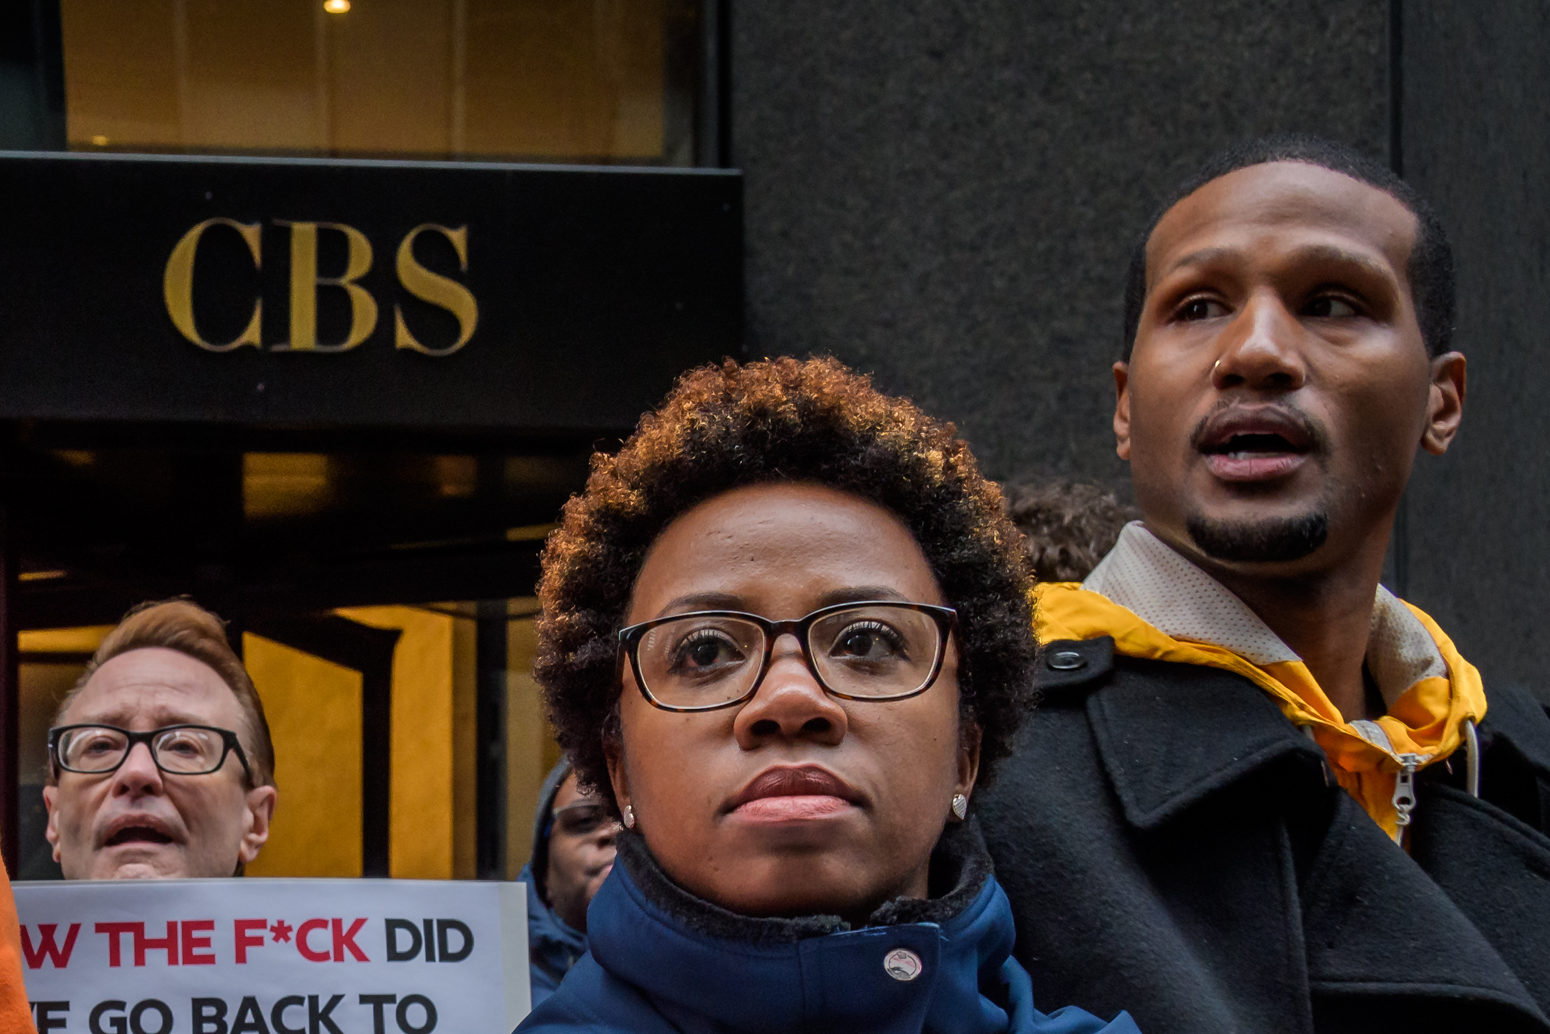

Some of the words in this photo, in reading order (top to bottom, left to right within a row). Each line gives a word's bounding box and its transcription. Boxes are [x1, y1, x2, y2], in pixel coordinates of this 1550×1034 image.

[163, 217, 479, 357] CBS
[94, 920, 216, 968] THE
[385, 918, 475, 963] DID
